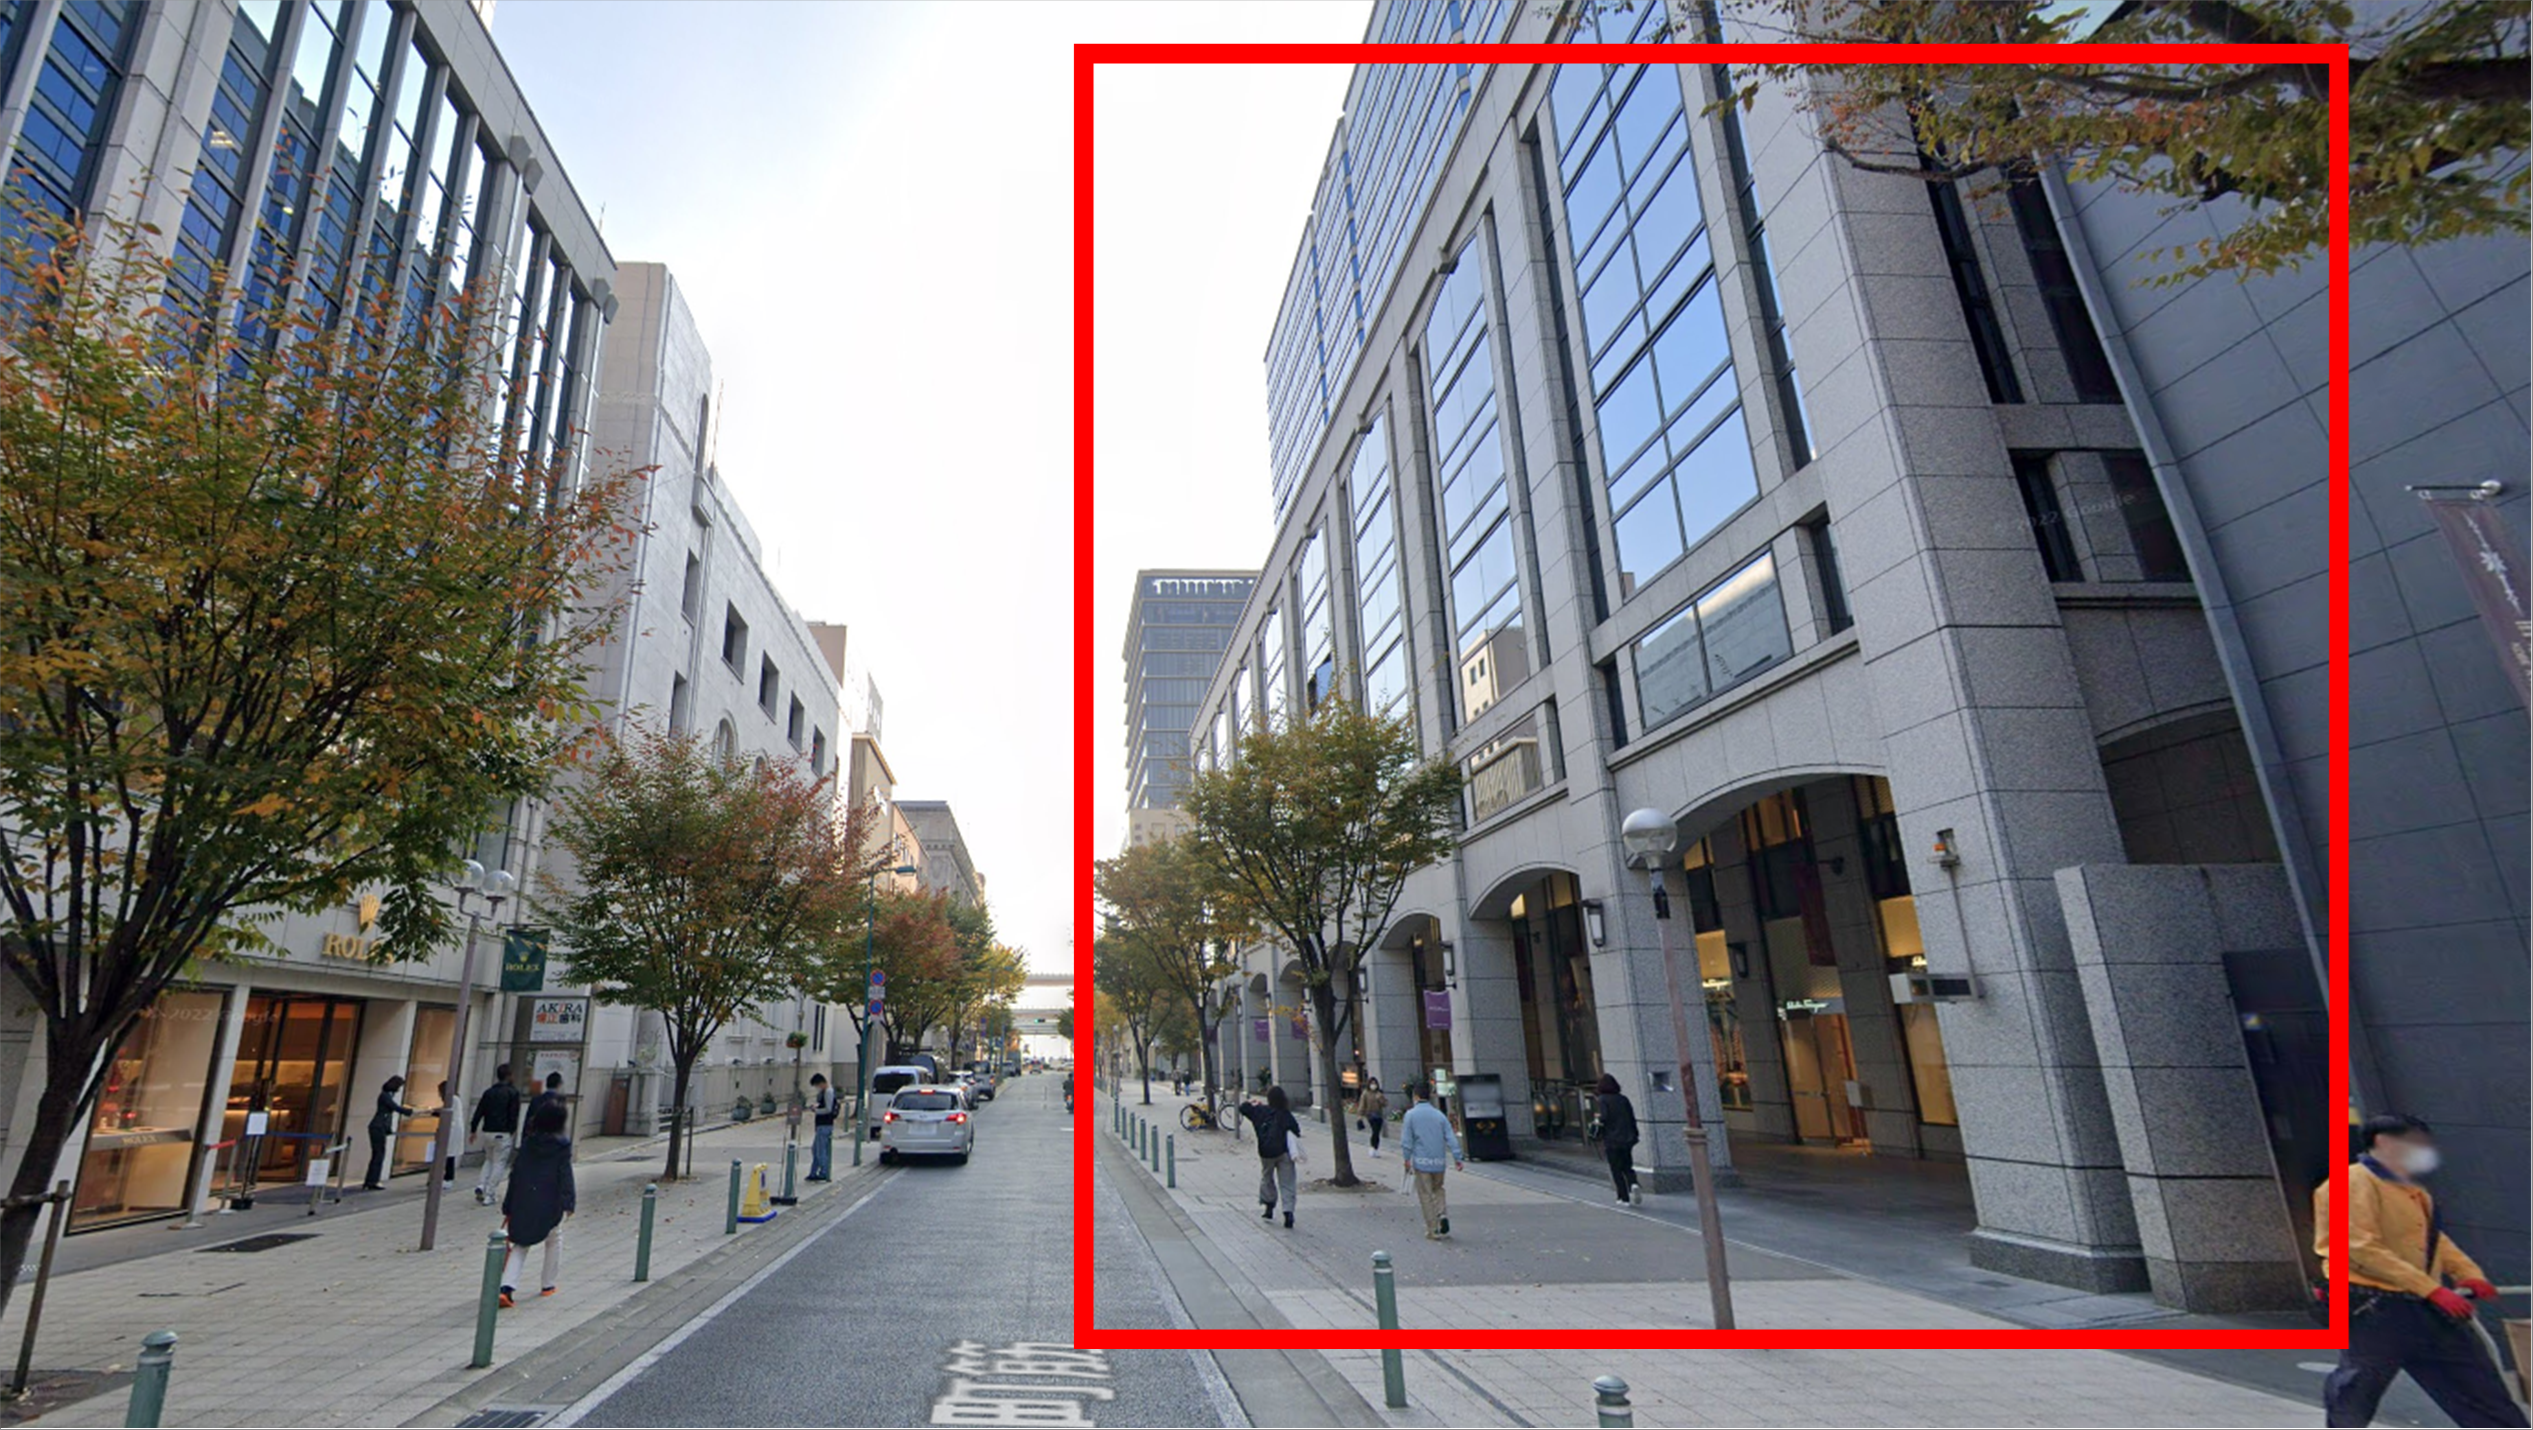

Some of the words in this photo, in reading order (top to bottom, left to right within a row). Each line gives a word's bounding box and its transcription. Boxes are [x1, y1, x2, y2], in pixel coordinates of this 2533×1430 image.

[321, 933, 396, 963] ROL
[505, 963, 540, 972] ROLEX
[536, 1003, 583, 1013] AKIRA
